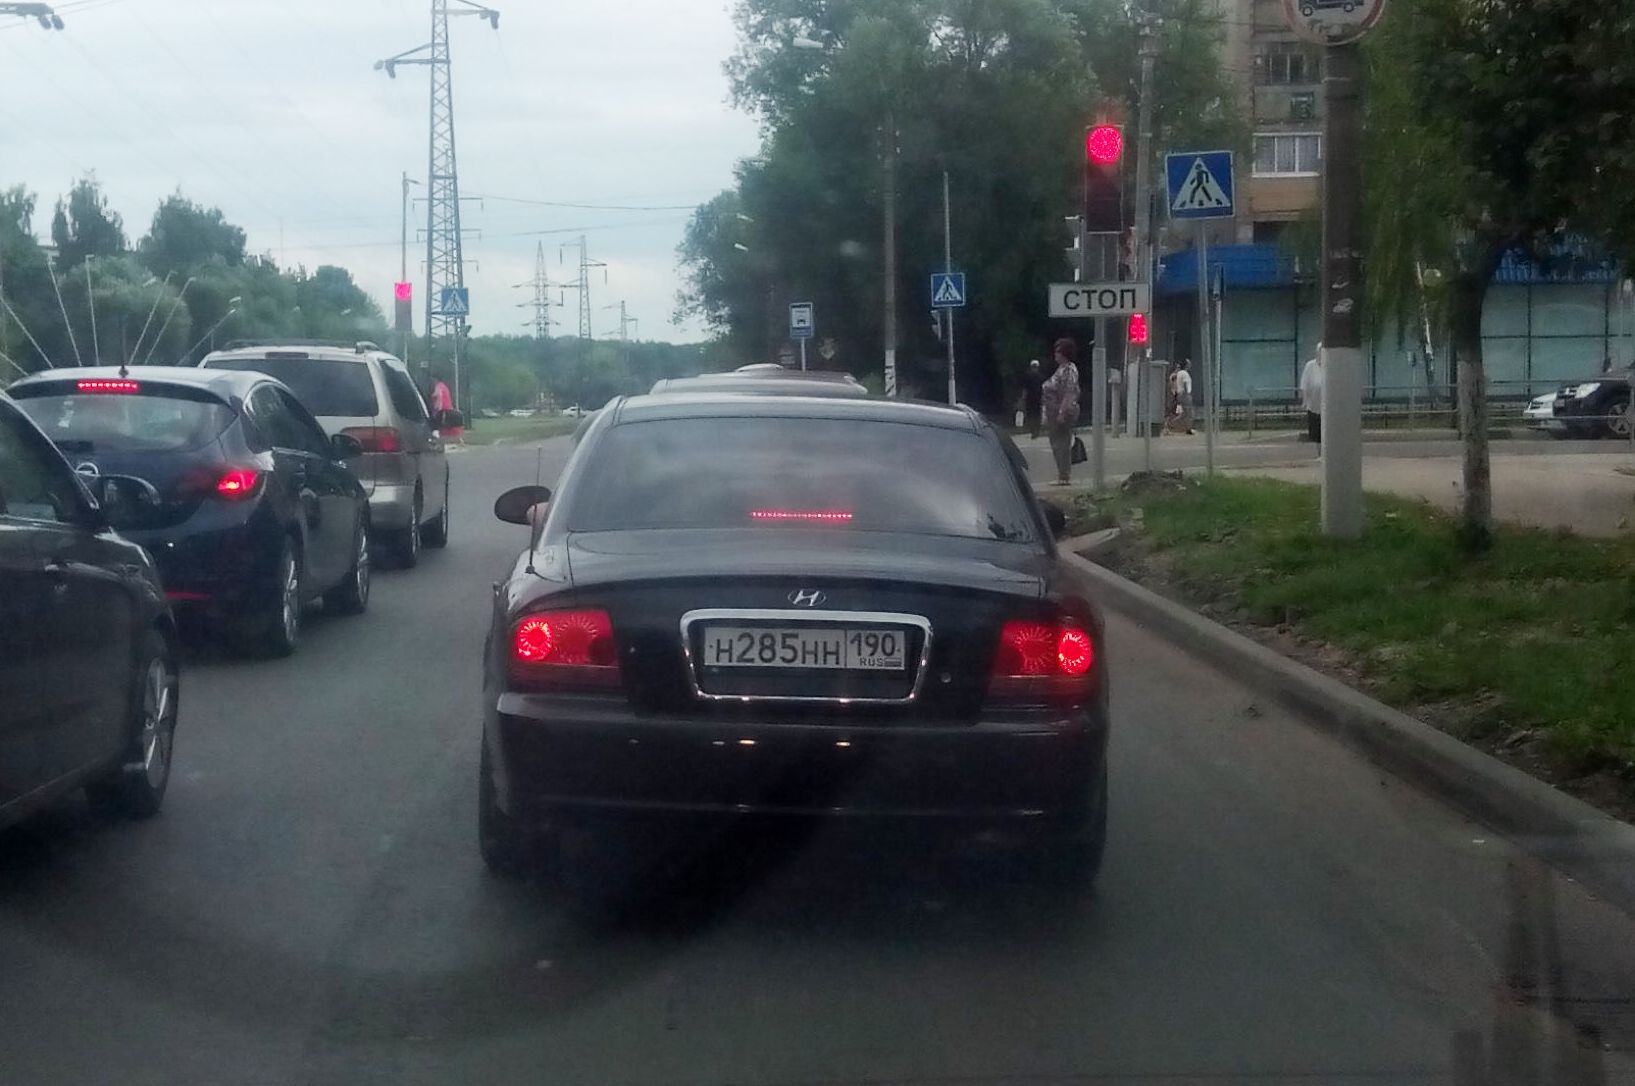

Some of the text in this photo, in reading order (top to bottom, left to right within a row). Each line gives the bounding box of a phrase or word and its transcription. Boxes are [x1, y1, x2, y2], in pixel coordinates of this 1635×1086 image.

[1064, 289, 1136, 310] СТОП
[850, 632, 896, 657] 190
[859, 657, 884, 667] RUS
